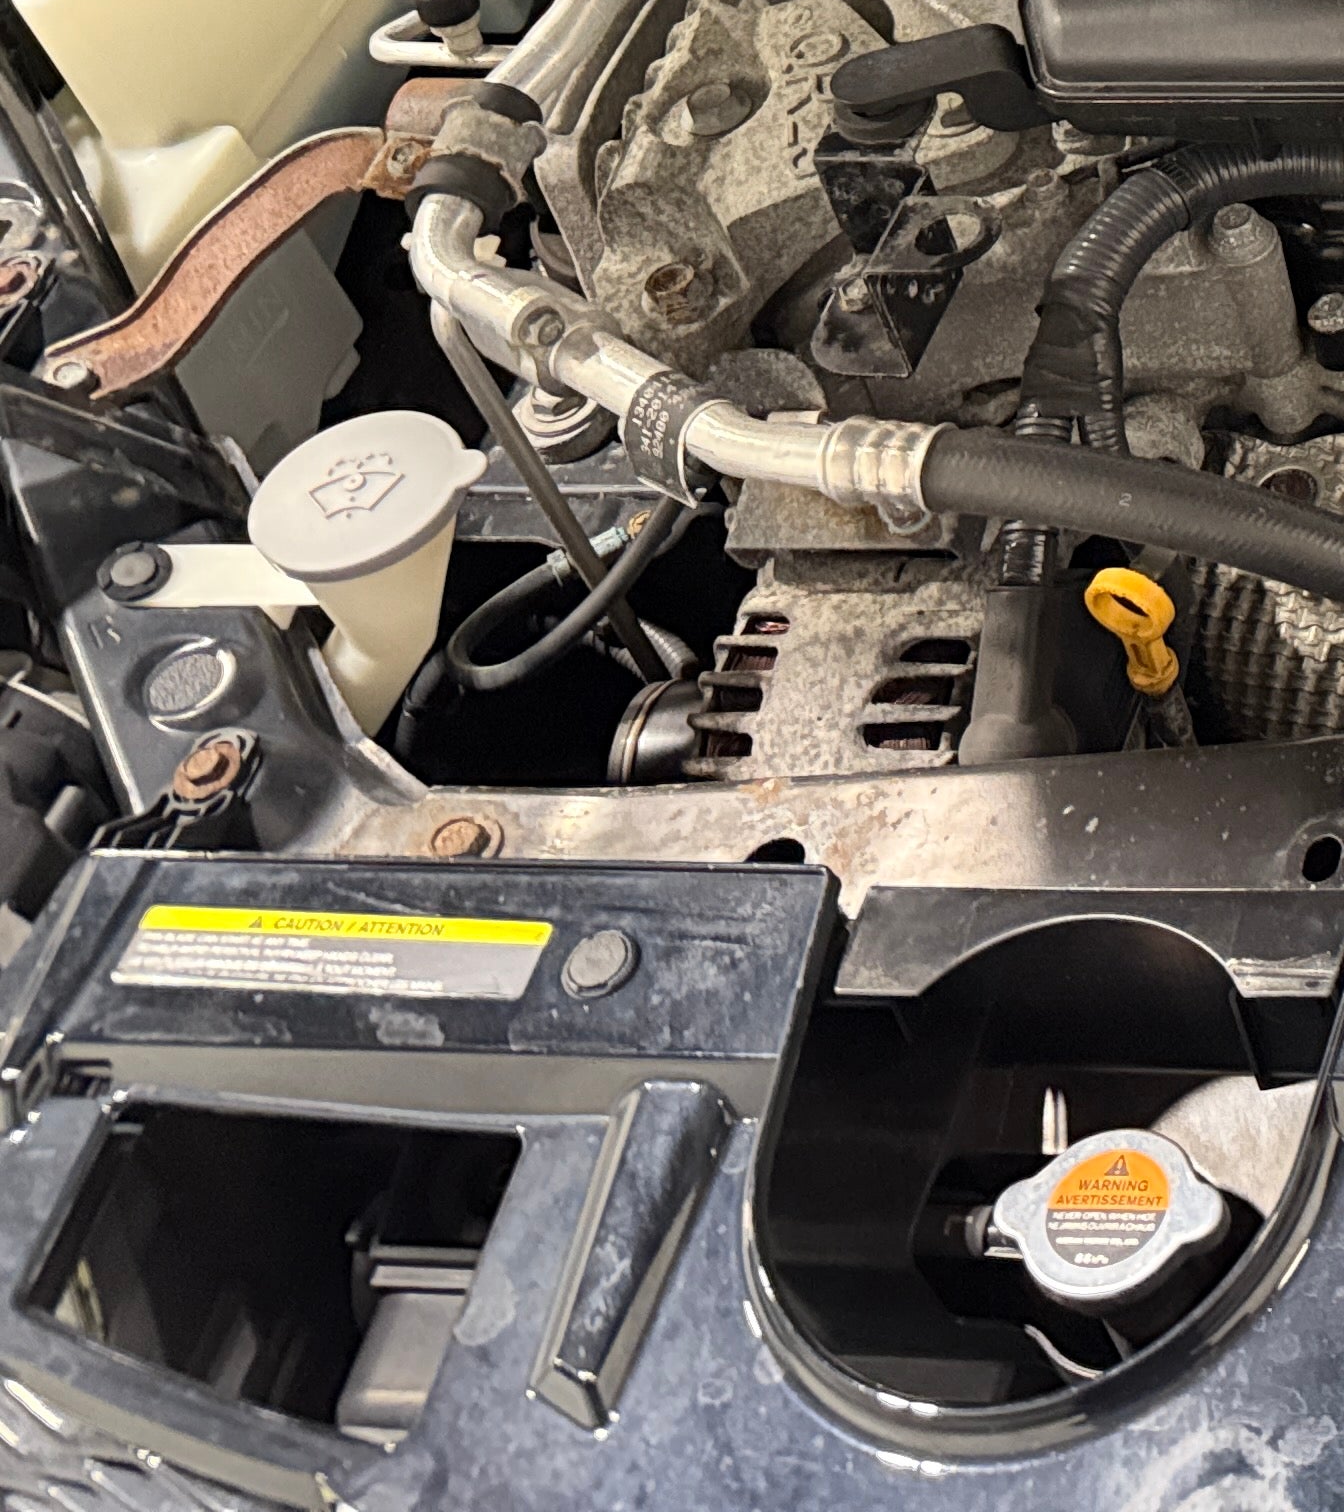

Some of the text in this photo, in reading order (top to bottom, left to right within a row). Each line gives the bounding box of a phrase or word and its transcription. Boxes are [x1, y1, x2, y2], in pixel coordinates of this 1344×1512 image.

[1119, 492, 1132, 507] 2
[274, 917, 344, 932] CAUTION
[359, 920, 445, 936] ATTENTION
[1078, 1179, 1149, 1192] WARNING
[1056, 1193, 1164, 1207] AVERTISSEMENT
